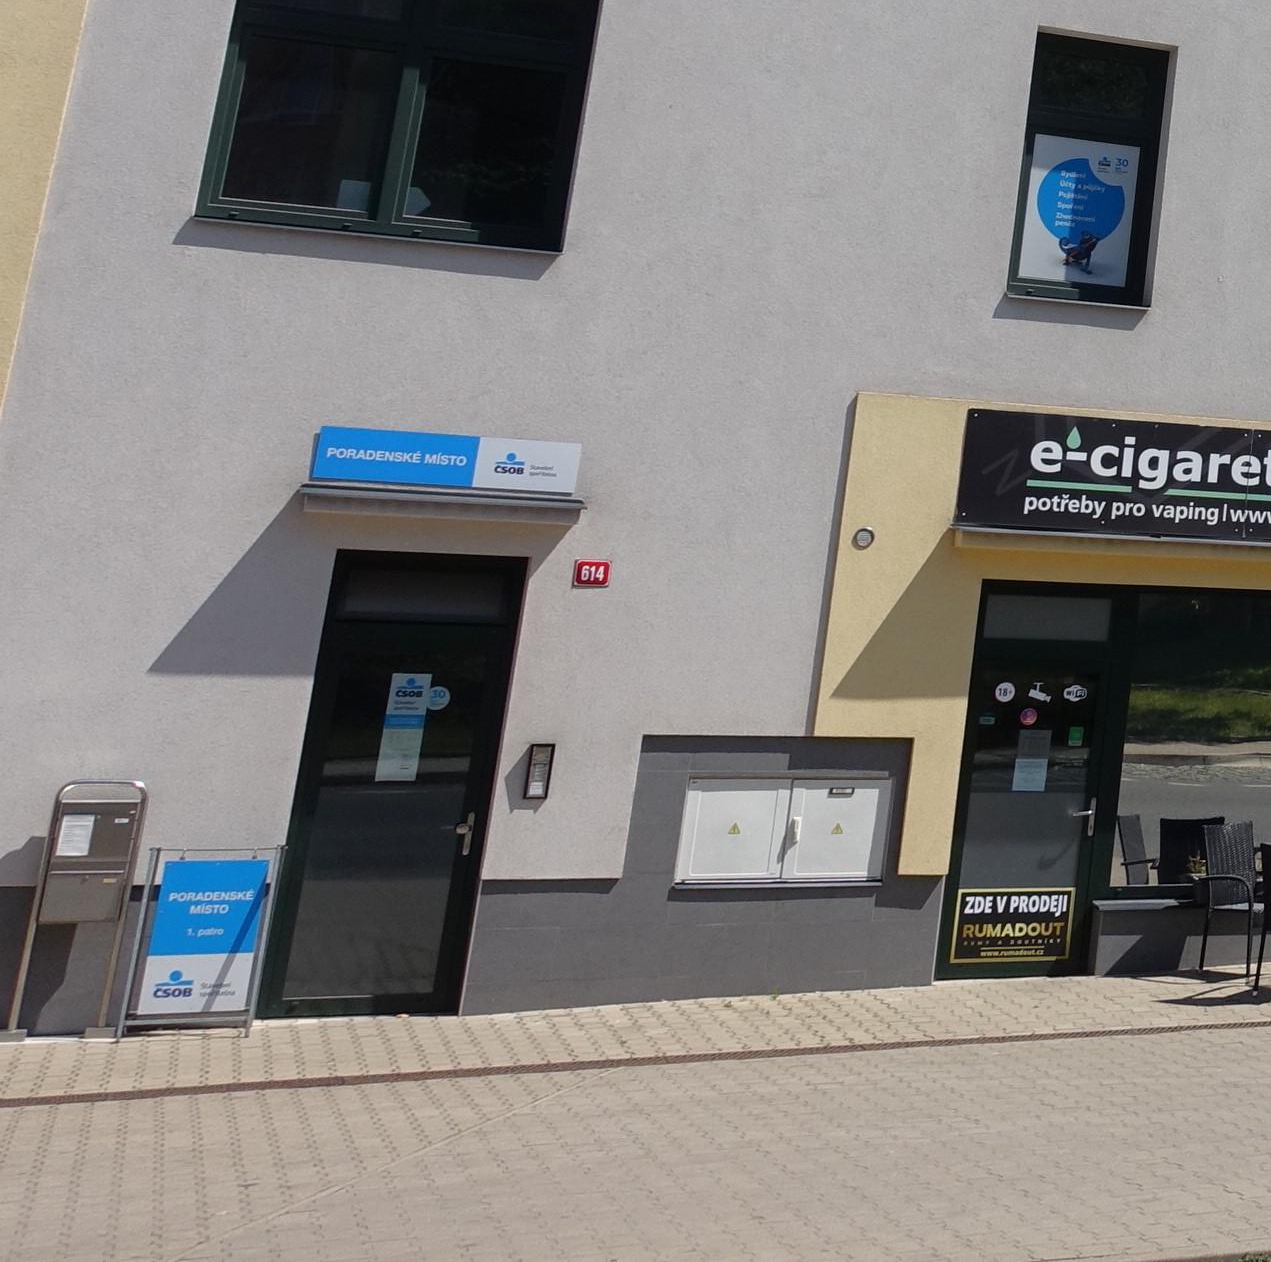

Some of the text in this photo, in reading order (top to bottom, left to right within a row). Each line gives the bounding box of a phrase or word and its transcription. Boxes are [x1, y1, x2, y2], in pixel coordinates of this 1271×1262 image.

[326, 447, 467, 467] PORADENSKÉ MÍSTO
[494, 464, 525, 476] ČSOB
[1023, 492, 1106, 519] potřeby
[1111, 501, 1146, 520] pro
[581, 565, 604, 581] 614
[998, 688, 1013, 698] 18+
[168, 889, 255, 902] PORADENSKÉ
[189, 903, 229, 915] MÍSTO
[964, 895, 1068, 917] ZDE V PRODEJI
[197, 928, 224, 937] patro
[962, 922, 1065, 938] RUMADOUT
[153, 987, 193, 999] ČSOB
